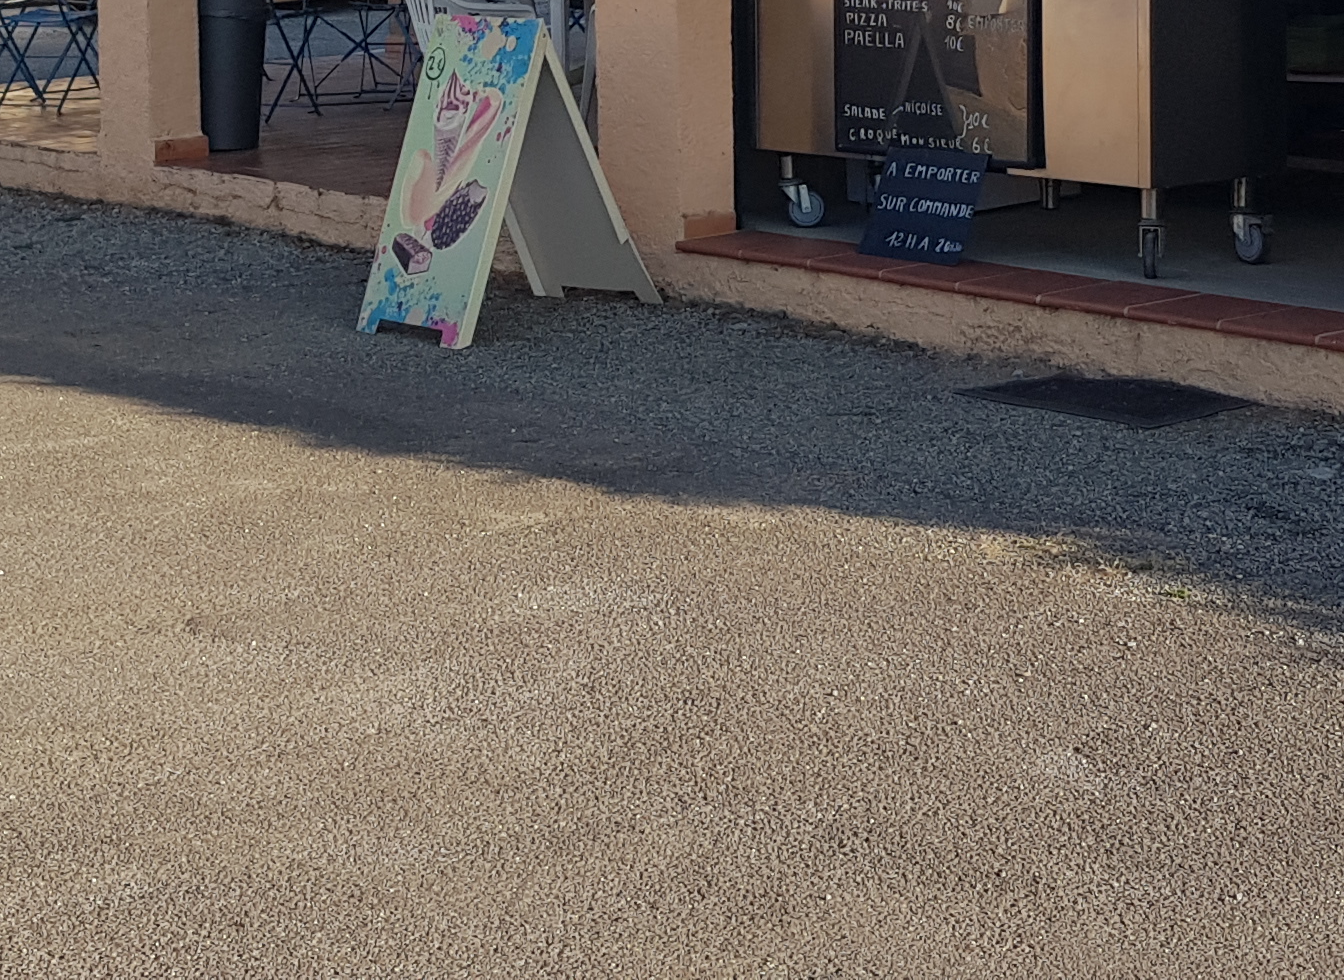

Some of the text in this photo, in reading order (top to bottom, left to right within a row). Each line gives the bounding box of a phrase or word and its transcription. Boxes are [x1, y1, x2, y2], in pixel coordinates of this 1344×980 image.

[846, 10, 887, 27] PIZZA
[844, 104, 886, 120] SALADE
[886, 161, 980, 183] A EMPORTER
[877, 193, 974, 219] SUR COMMANDE
